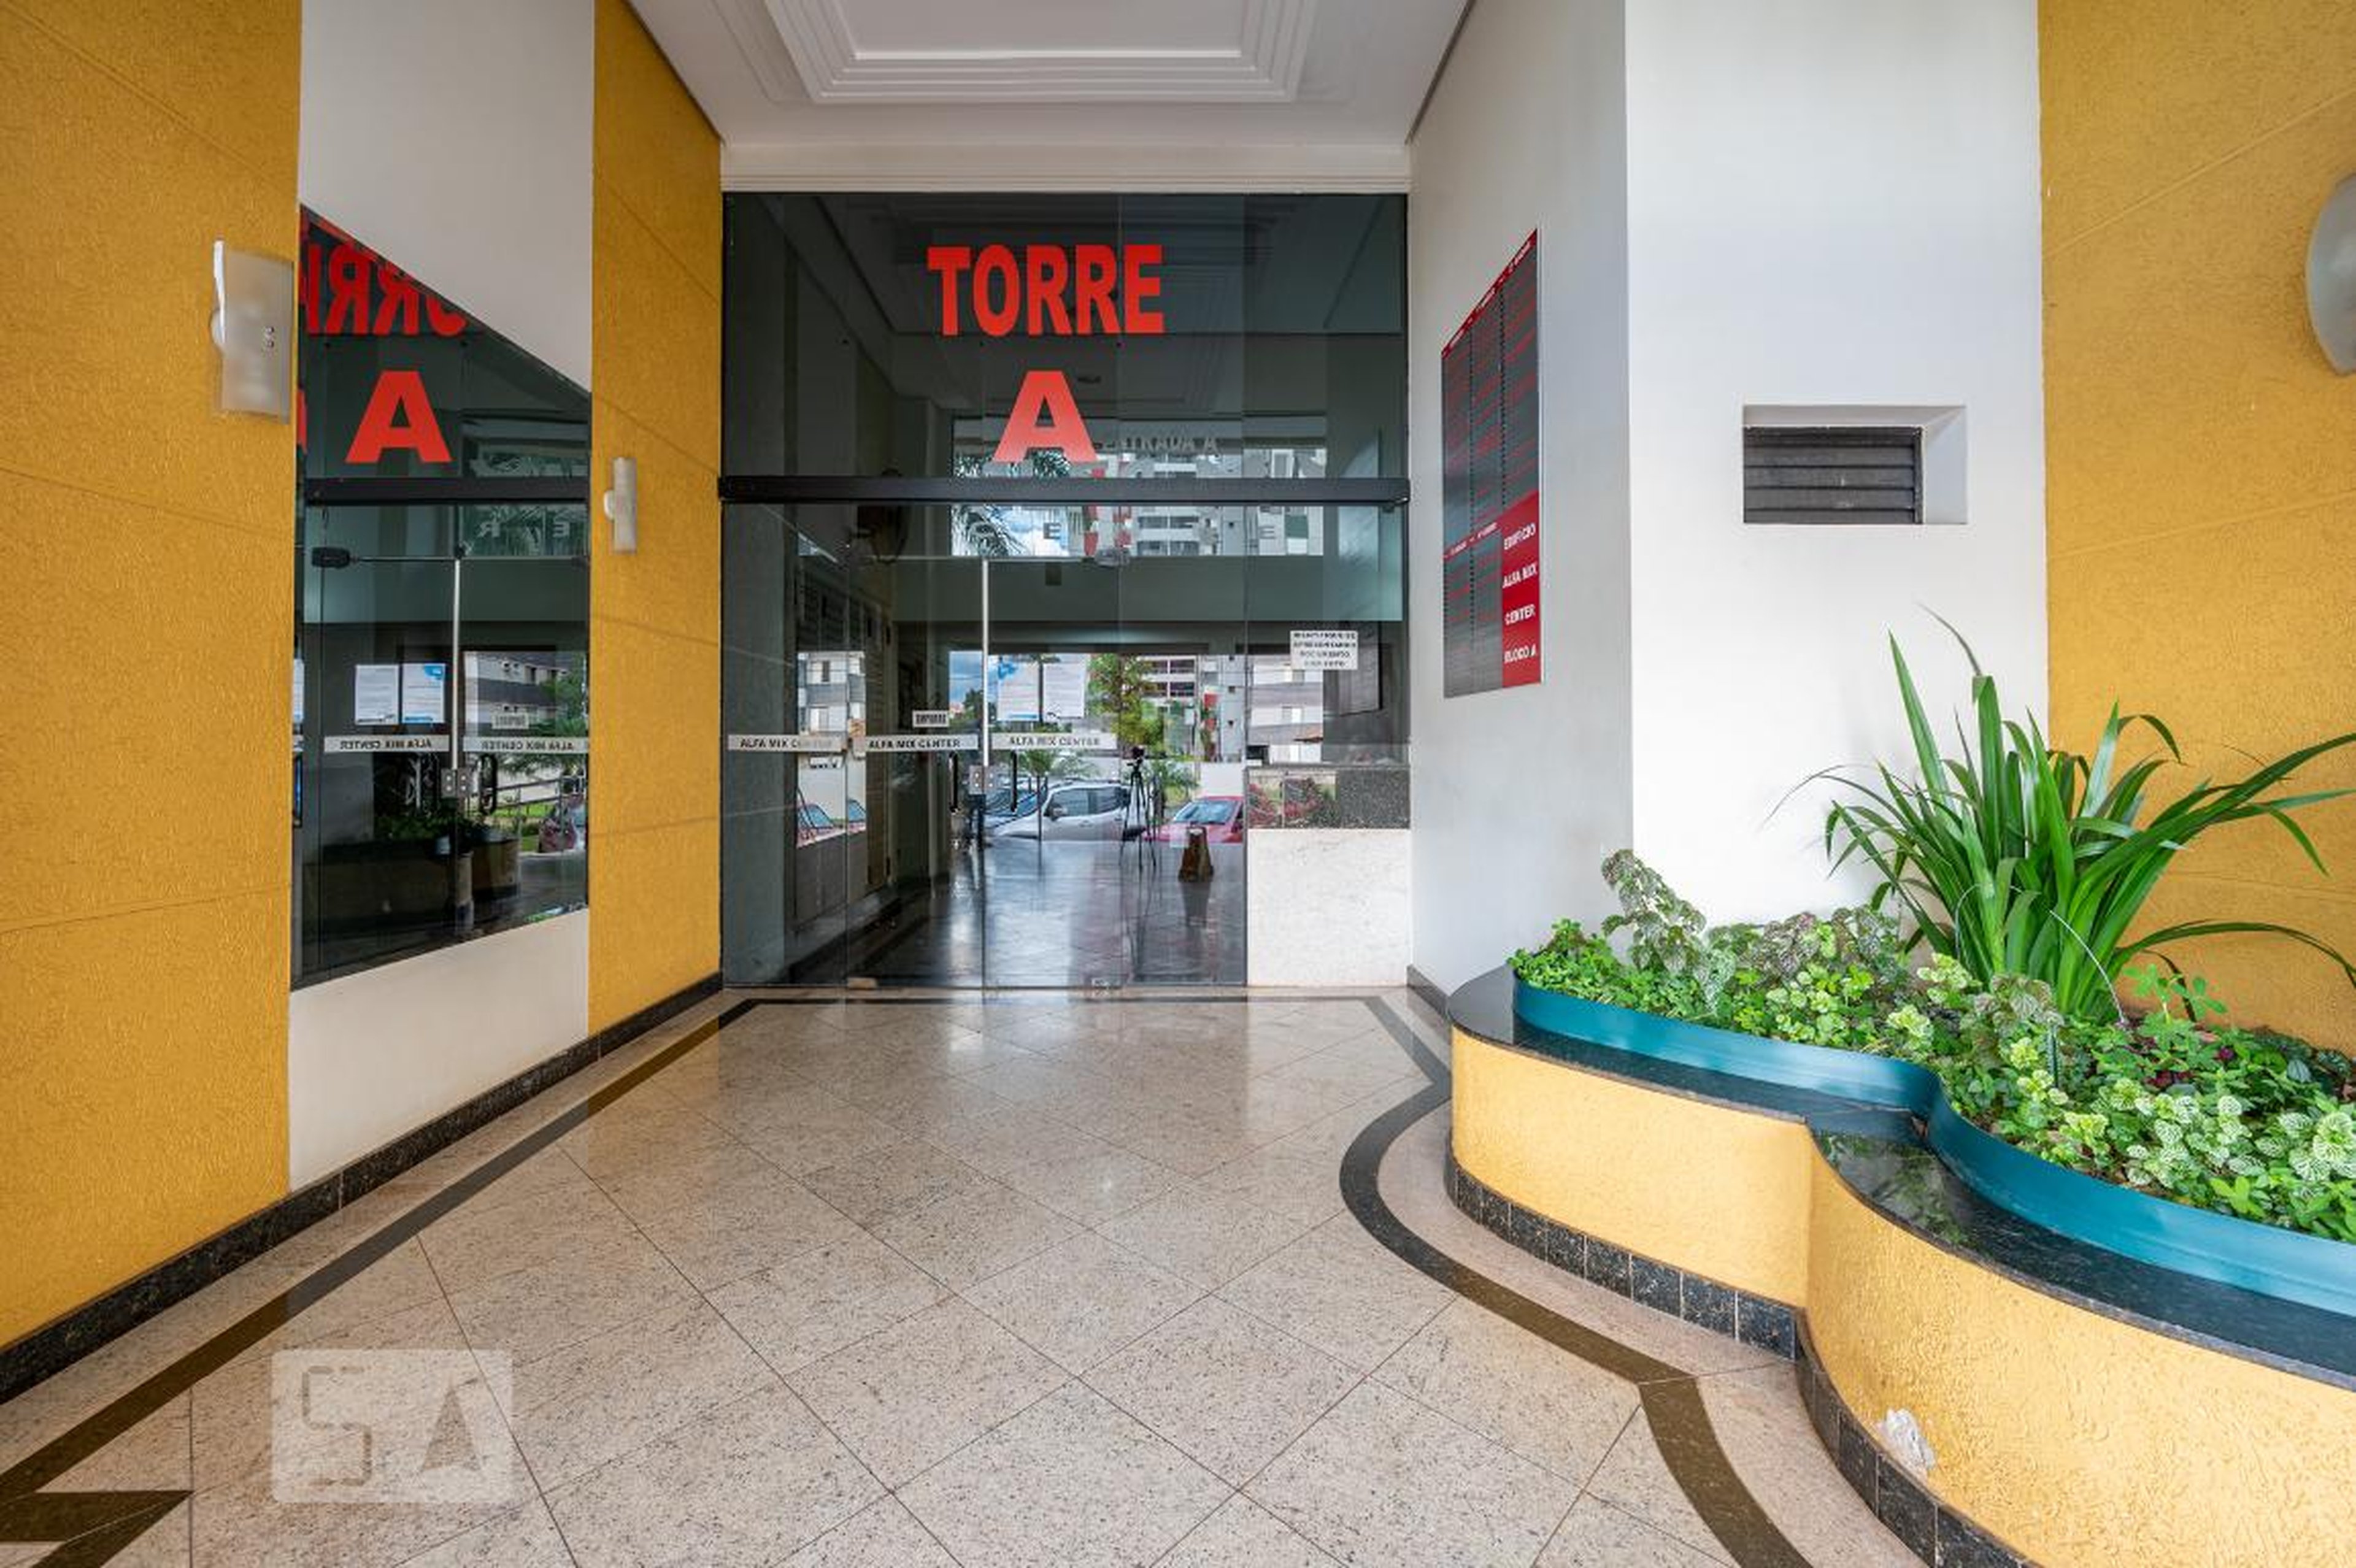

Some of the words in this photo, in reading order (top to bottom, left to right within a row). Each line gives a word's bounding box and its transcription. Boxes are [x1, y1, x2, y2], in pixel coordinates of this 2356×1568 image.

[927, 244, 1165, 337] TORRE
[992, 370, 1100, 463] A
[1505, 604, 1536, 626] CENTER
[740, 738, 766, 748] ALFA
[869, 739, 893, 748] ALFA
[898, 739, 915, 748] MIX
[918, 738, 961, 748] CENTER
[1010, 737, 1034, 747] ALFA
[1059, 737, 1100, 747] CENTER
